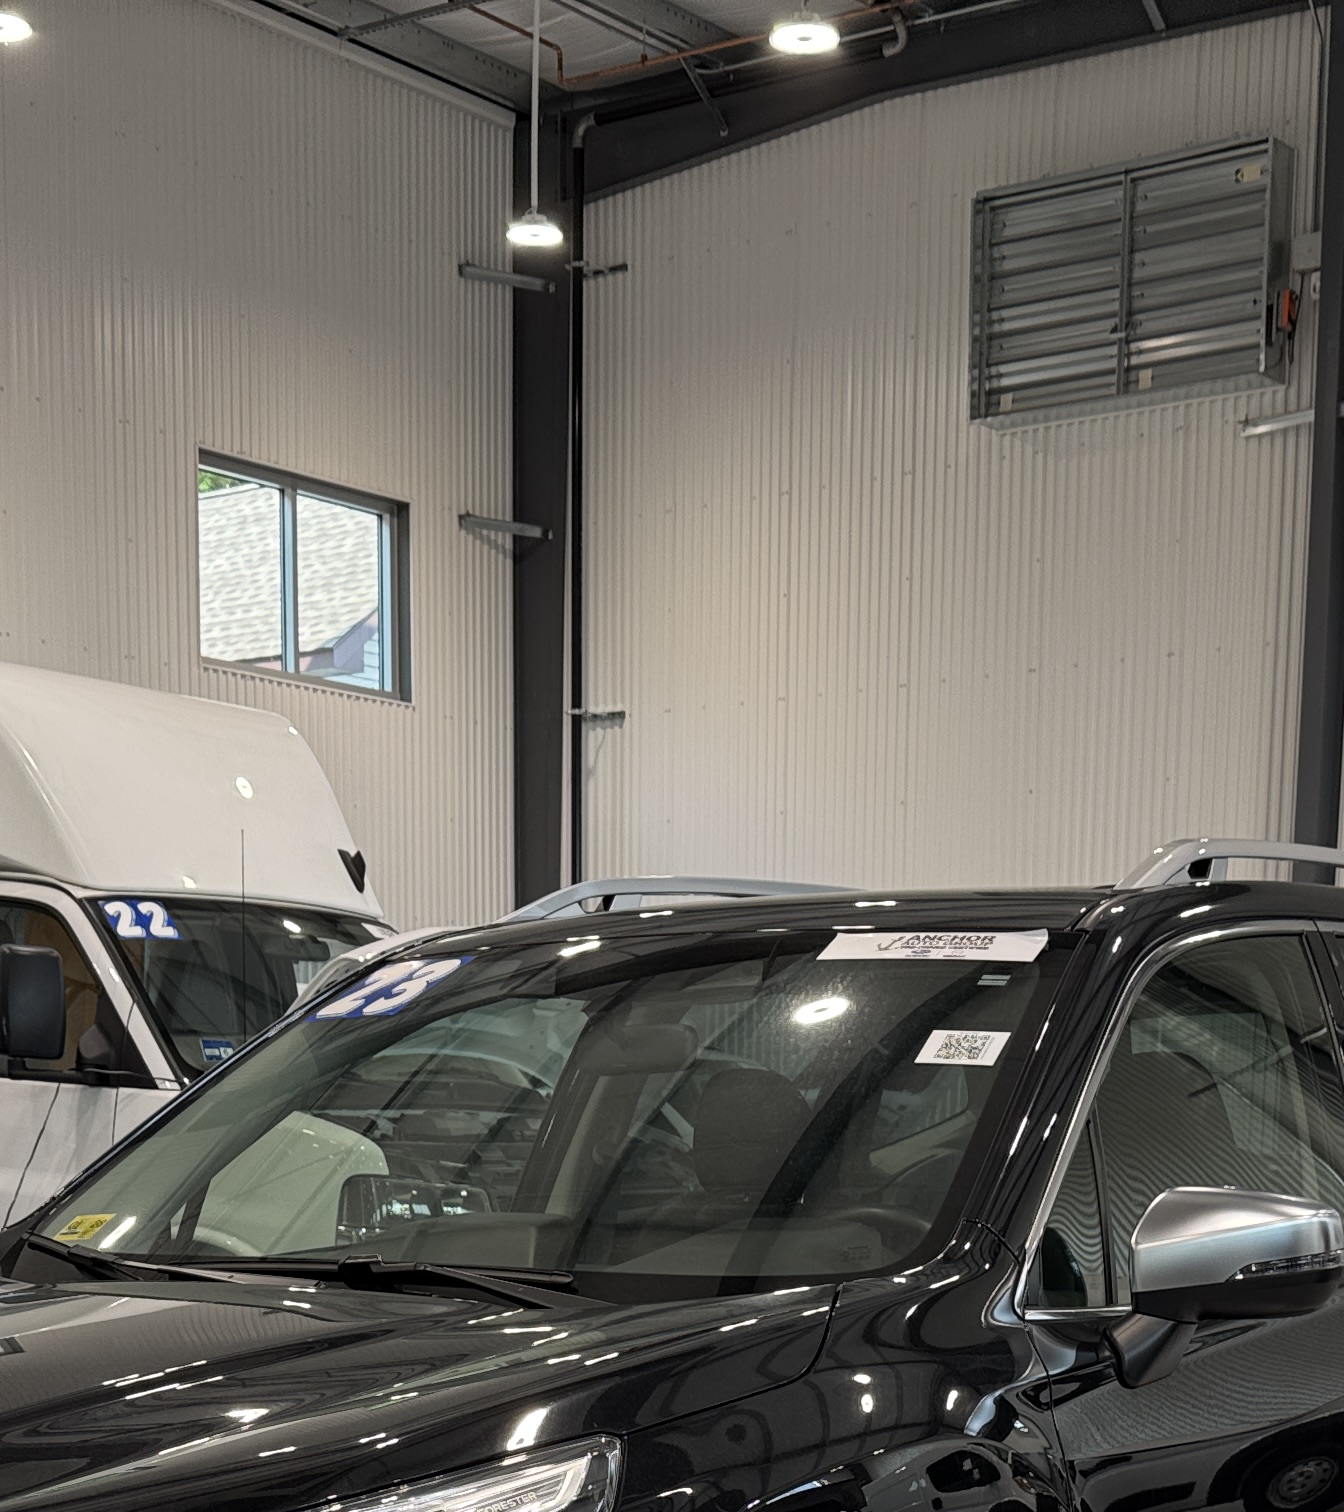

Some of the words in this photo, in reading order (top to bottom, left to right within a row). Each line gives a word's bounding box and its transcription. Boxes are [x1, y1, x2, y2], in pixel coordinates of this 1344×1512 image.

[103, 901, 179, 938] 22
[905, 934, 996, 942] ANCHOR
[316, 959, 462, 1018] 23
